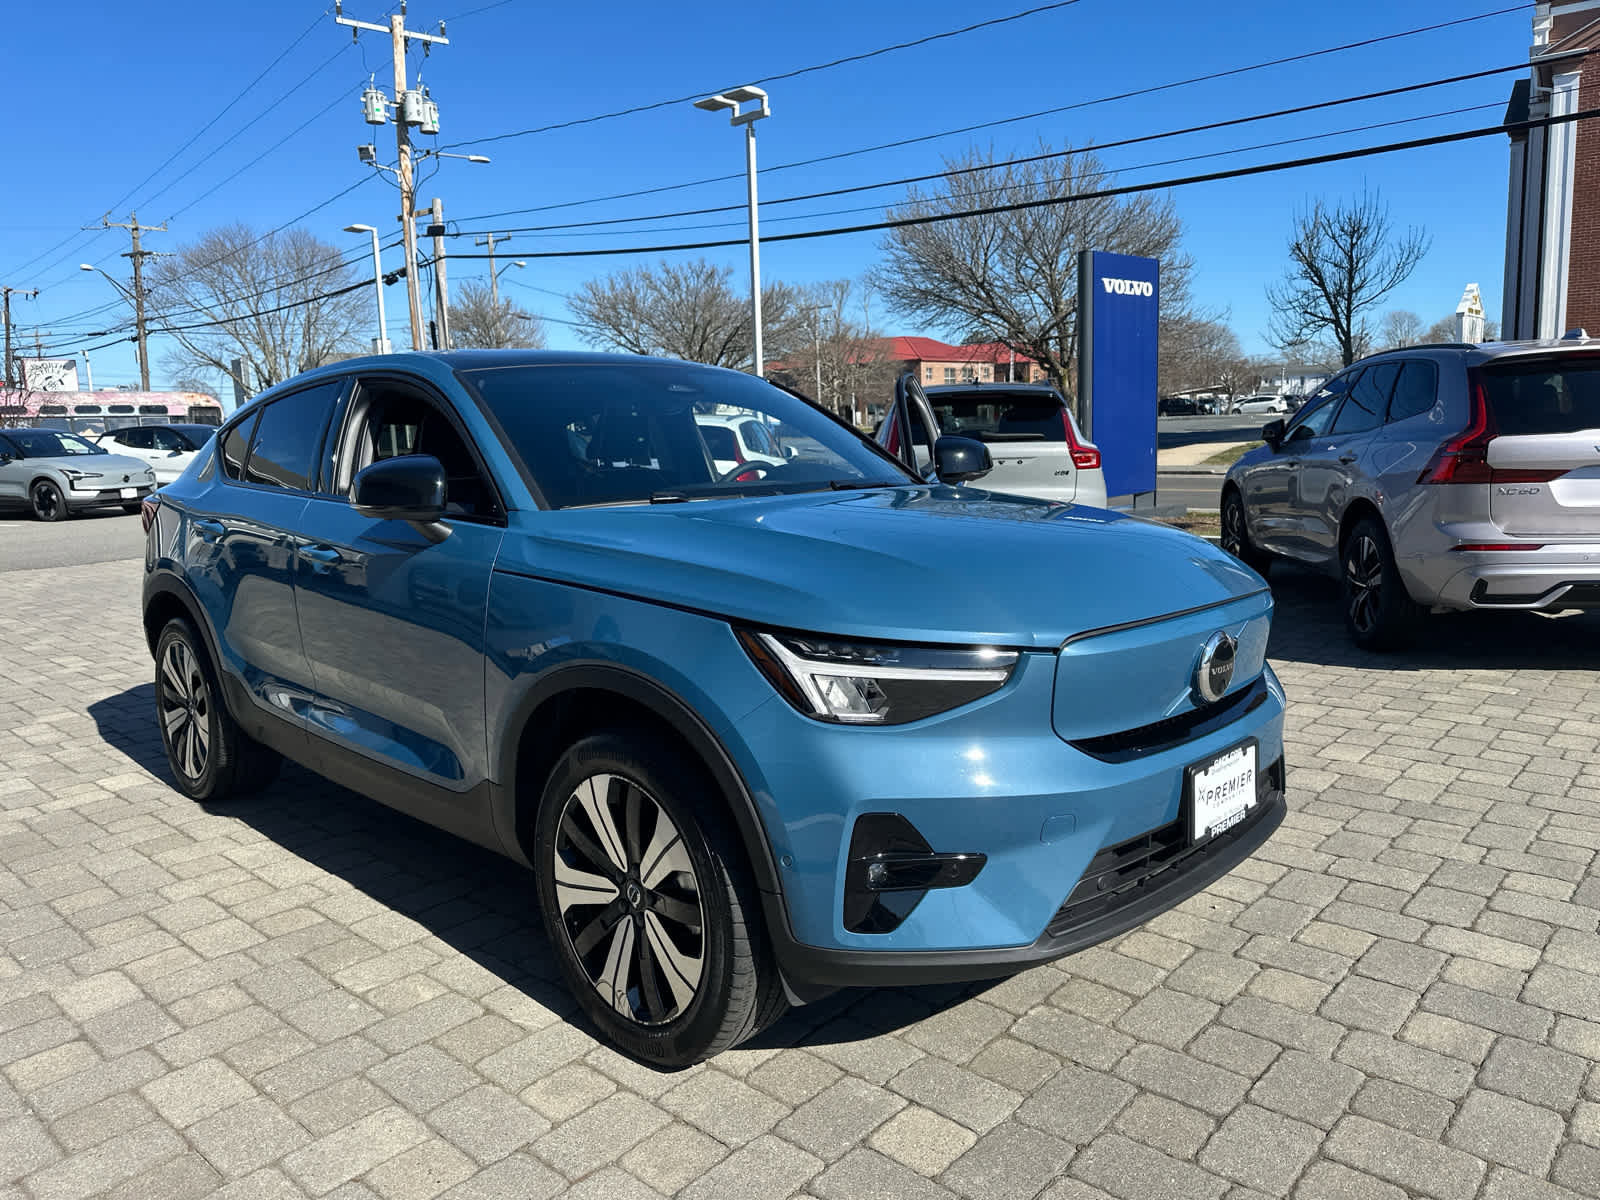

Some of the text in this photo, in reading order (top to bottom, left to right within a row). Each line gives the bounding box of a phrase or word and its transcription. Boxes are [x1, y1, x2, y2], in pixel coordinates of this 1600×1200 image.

[1101, 277, 1153, 296] VOLVO
[1206, 769, 1252, 805] PREMIER
[1211, 810, 1246, 838] PREMIER
